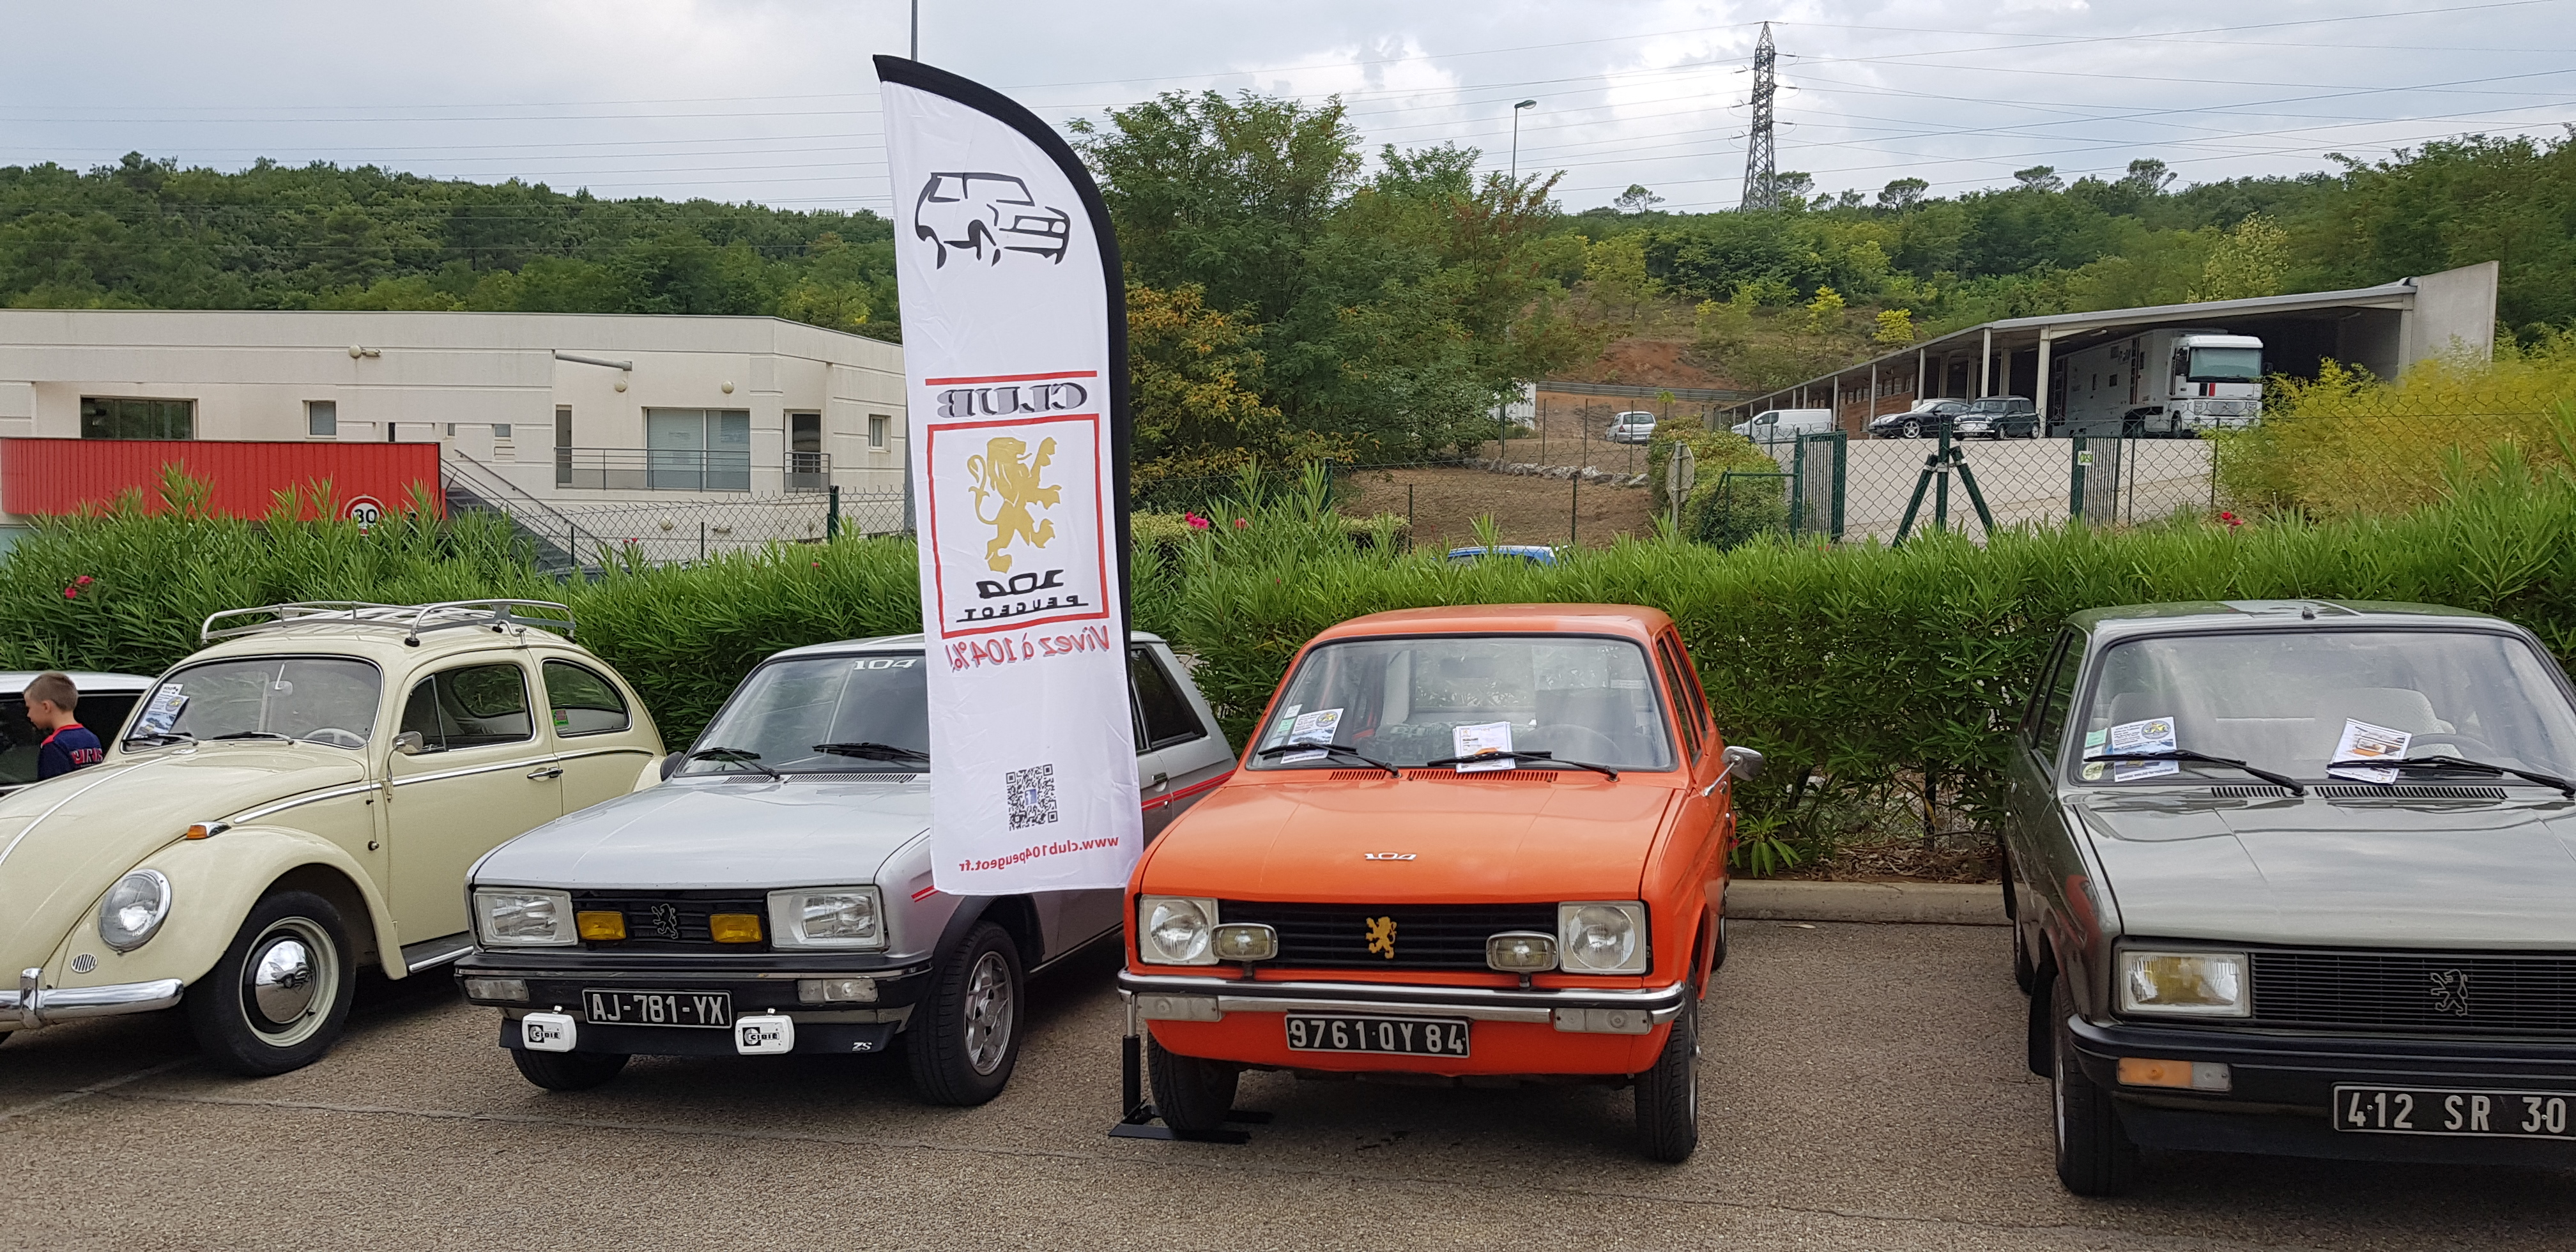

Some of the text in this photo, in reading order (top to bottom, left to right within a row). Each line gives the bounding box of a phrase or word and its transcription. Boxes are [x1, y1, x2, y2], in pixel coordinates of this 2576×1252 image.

[354, 508, 378, 524] 30
[853, 659, 917, 670] 104
[1364, 852, 1417, 860] 104
[592, 993, 724, 1025] AJ-781-YX
[1289, 1019, 1464, 1054] 9761 QY 84
[852, 1042, 873, 1051] ZS
[2347, 1092, 2566, 1134] 412 SR 30
